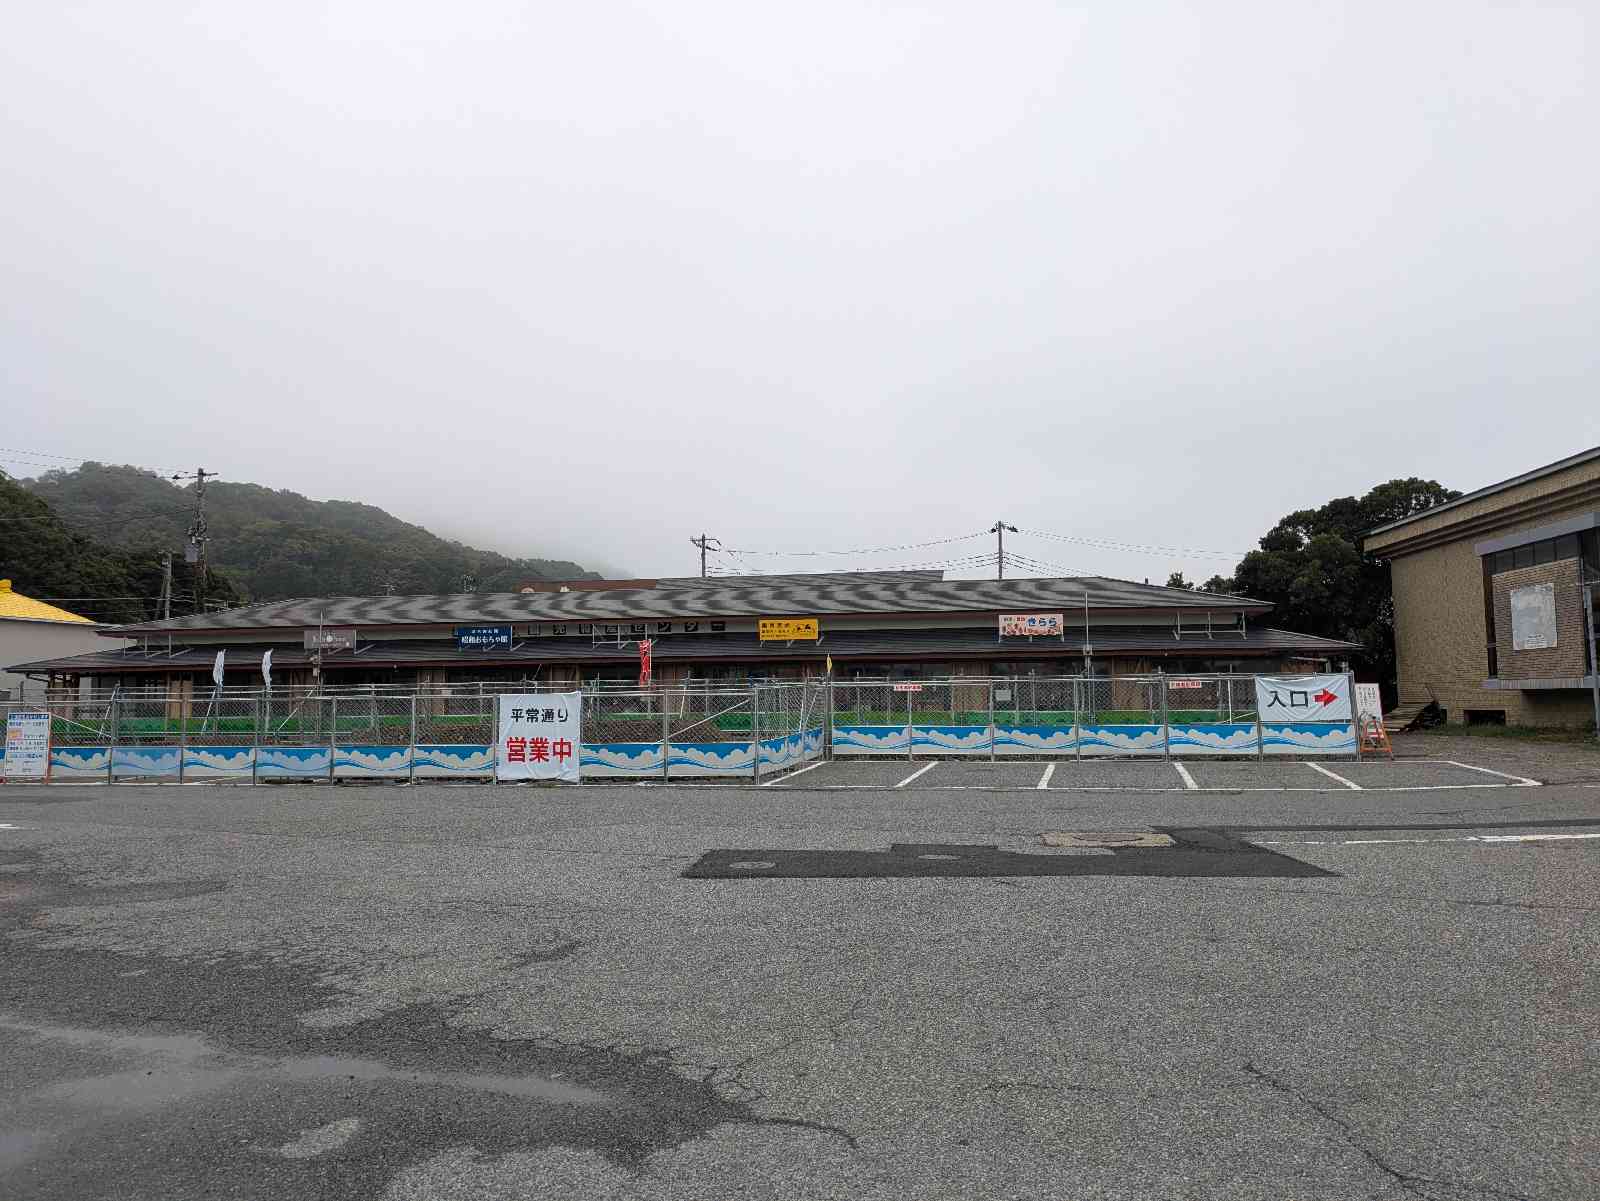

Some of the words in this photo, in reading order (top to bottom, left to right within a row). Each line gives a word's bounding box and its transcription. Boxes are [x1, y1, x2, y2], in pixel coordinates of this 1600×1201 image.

[1267, 690, 1309, 708] 入口
[510, 707, 569, 723] 平常通り
[506, 736, 572, 764] 営業中
